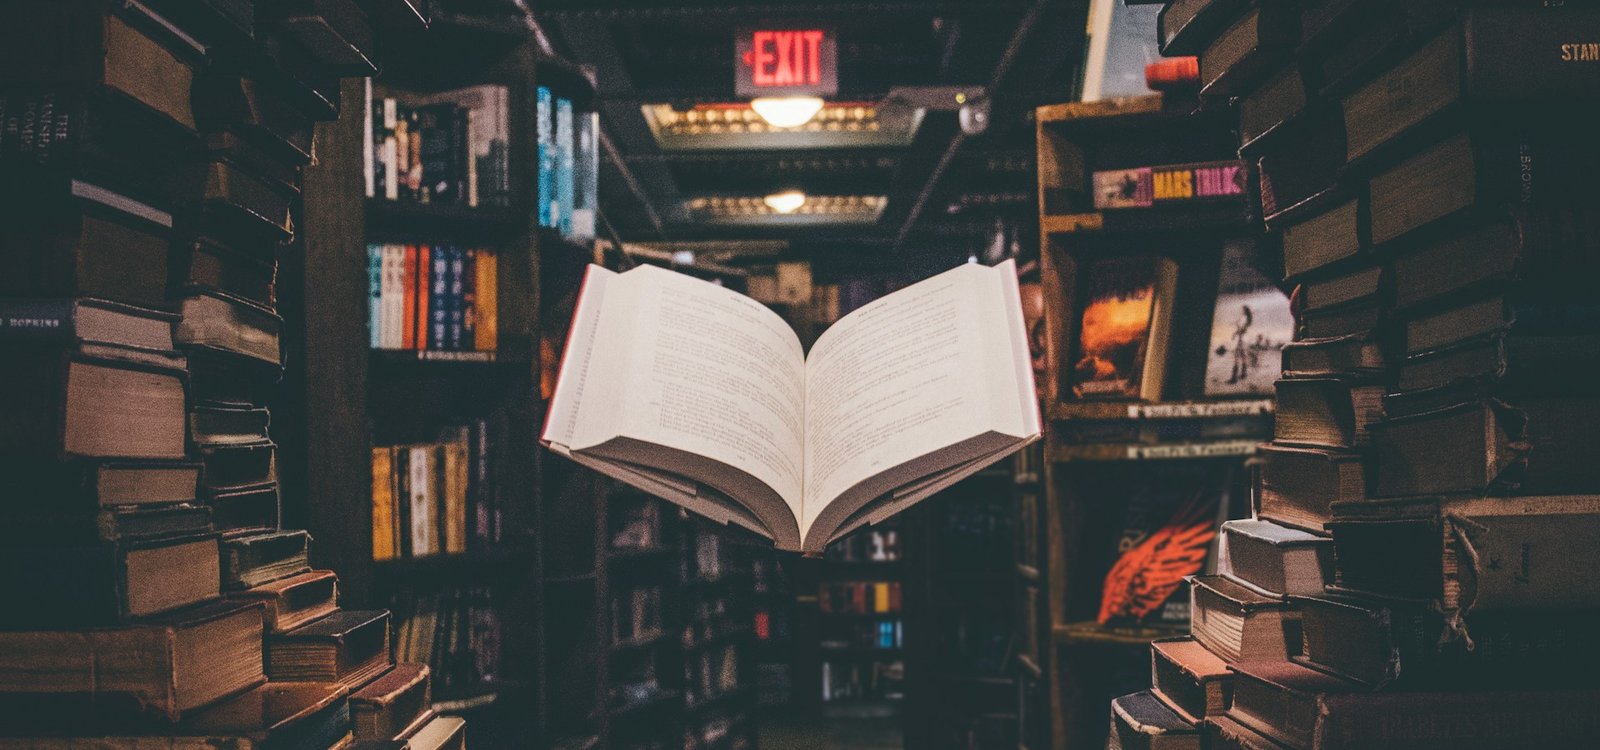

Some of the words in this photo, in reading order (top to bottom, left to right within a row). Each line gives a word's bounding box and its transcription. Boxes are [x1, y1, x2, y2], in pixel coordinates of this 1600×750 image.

[753, 30, 823, 86] EXIT
[1561, 43, 1600, 61] STAN
[55, 114, 69, 141] THE
[1153, 170, 1193, 199] MARS
[9, 317, 59, 327] HOPKINS
